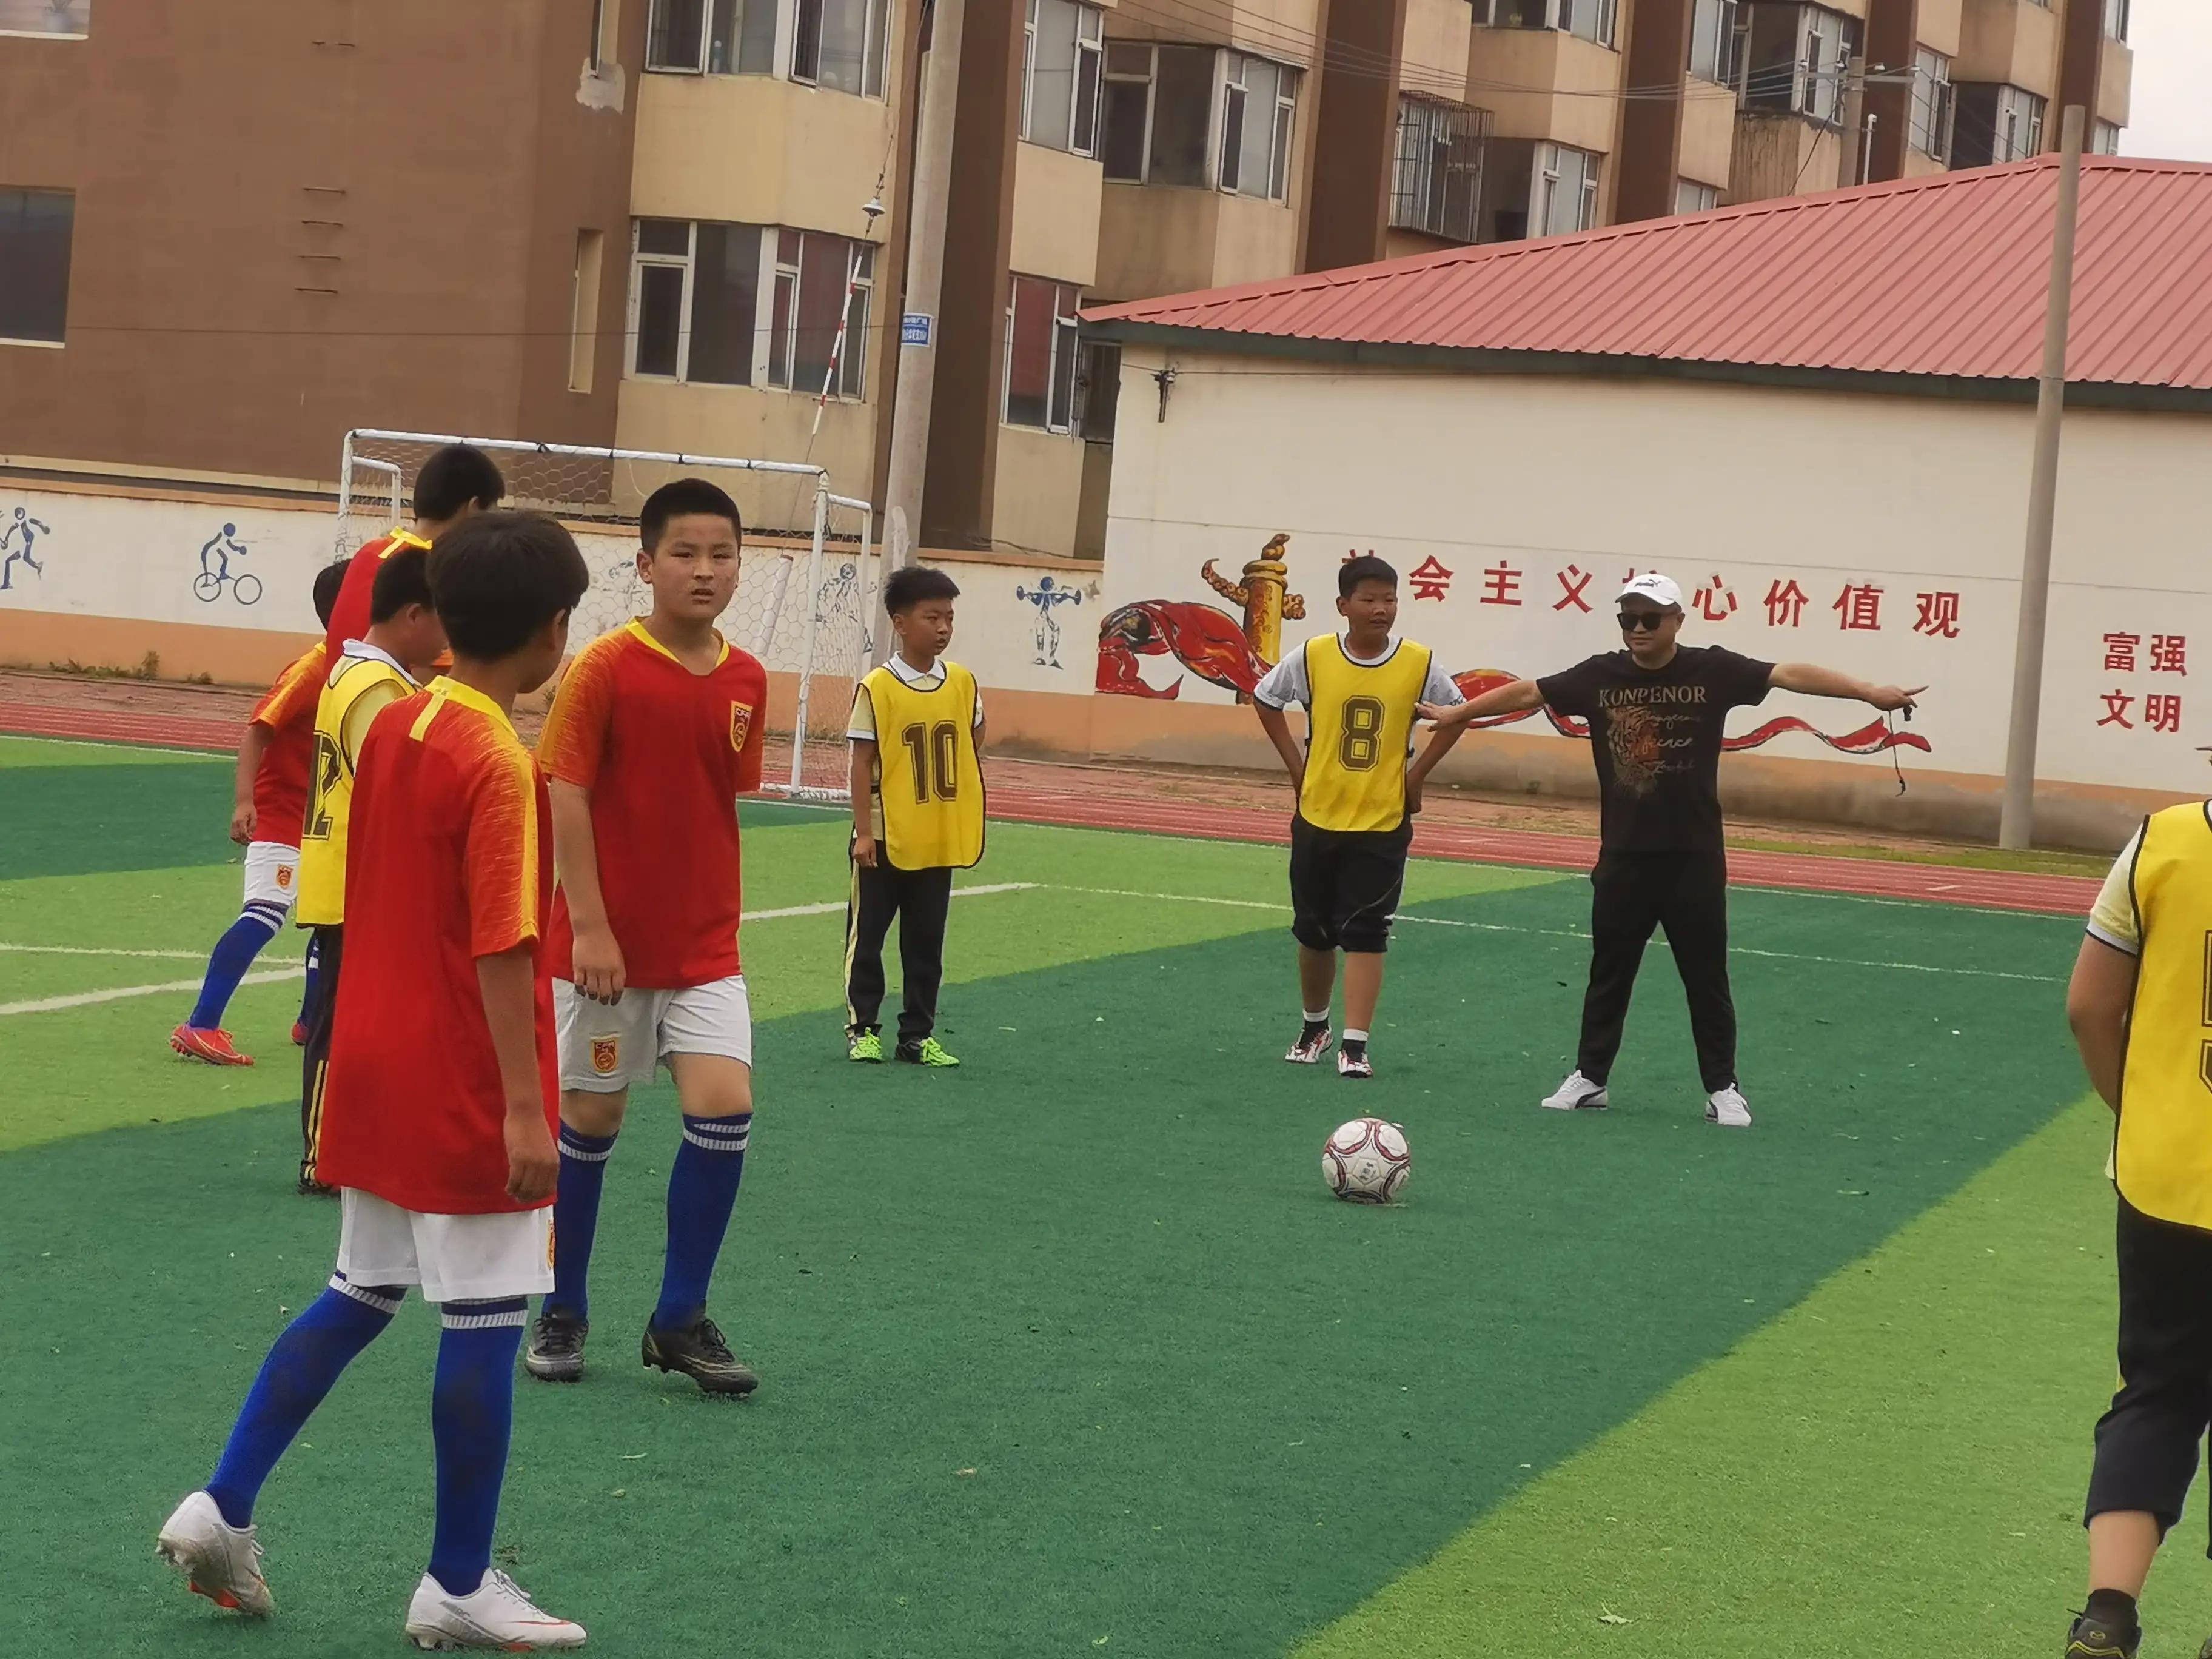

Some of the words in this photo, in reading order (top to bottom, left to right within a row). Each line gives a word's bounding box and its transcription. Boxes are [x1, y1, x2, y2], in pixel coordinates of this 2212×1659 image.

[1342, 549, 1960, 638] 会主义心价值观
[2103, 631, 2187, 677] 富强
[1598, 685, 1708, 708] KONPENOR
[2096, 688, 2182, 732] 文明
[902, 720, 958, 805] 10
[1338, 694, 1385, 772] 8
